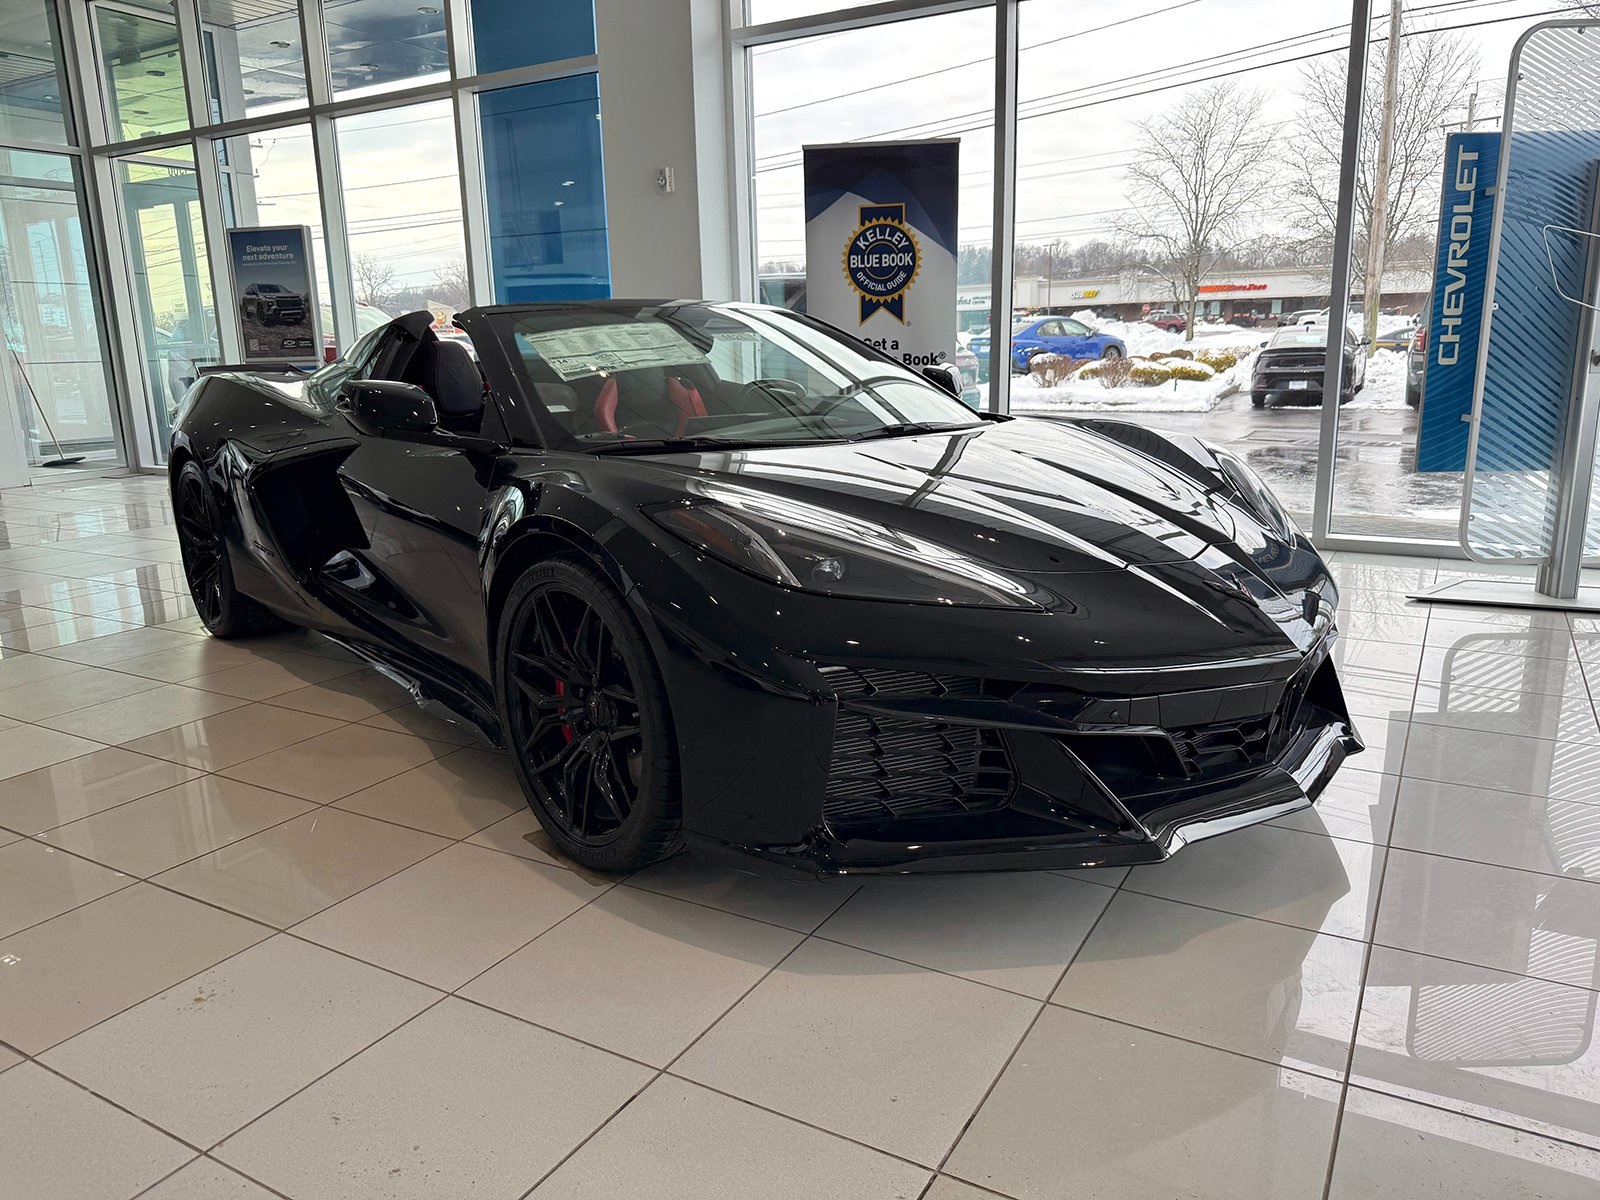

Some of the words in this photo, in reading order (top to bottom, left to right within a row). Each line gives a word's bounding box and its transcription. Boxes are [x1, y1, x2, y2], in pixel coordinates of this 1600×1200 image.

[856, 227, 909, 250] KELLEY
[246, 245, 271, 253] Elevate
[272, 244, 288, 252] your
[1438, 144, 1479, 366] CHEVROLET
[242, 253, 257, 261] next
[258, 252, 294, 261] adventure
[850, 254, 880, 268] BLUE
[881, 252, 913, 267] BOOK
[856, 271, 887, 291] OFFICIAL
[886, 270, 907, 290] GUIDE
[1071, 289, 1100, 299] SUBWAY
[890, 340, 899, 350] a
